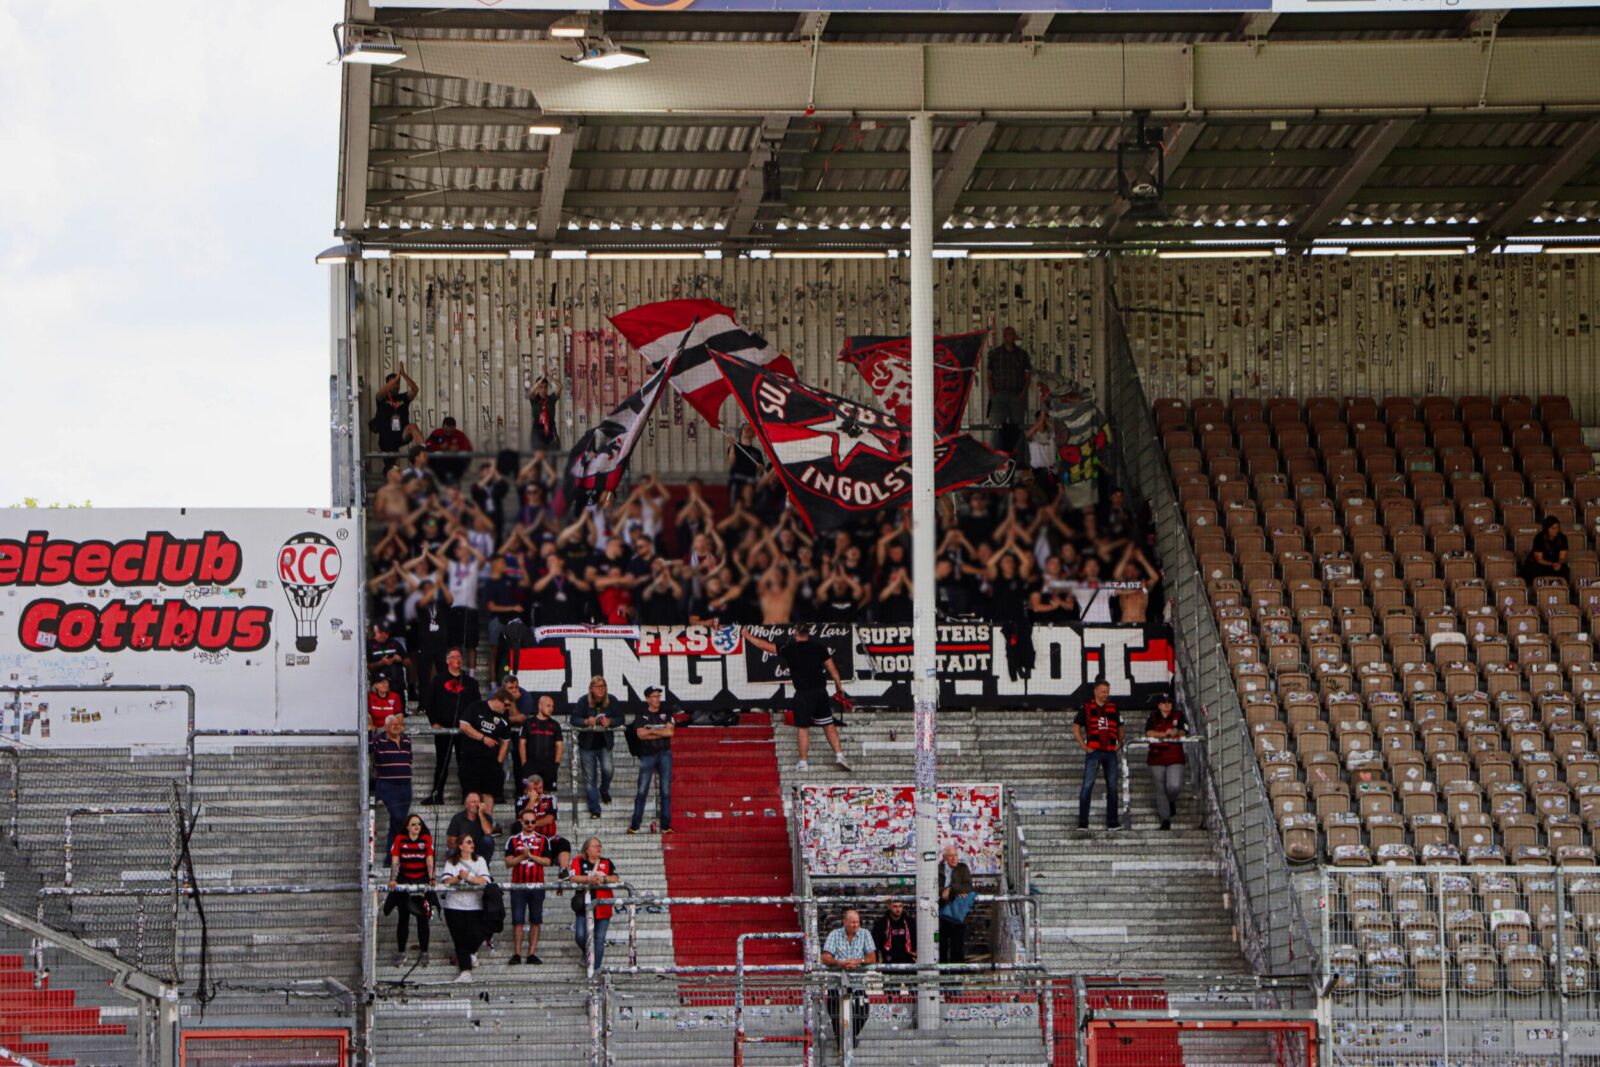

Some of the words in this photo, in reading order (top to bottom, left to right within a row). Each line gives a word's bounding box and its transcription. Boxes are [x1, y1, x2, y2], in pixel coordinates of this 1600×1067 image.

[279, 546, 339, 584] RCC
[20, 599, 271, 652] Cottbus
[819, 623, 850, 638] Lars
[858, 625, 990, 645] SUPPTERS
[638, 626, 708, 653] FKS
